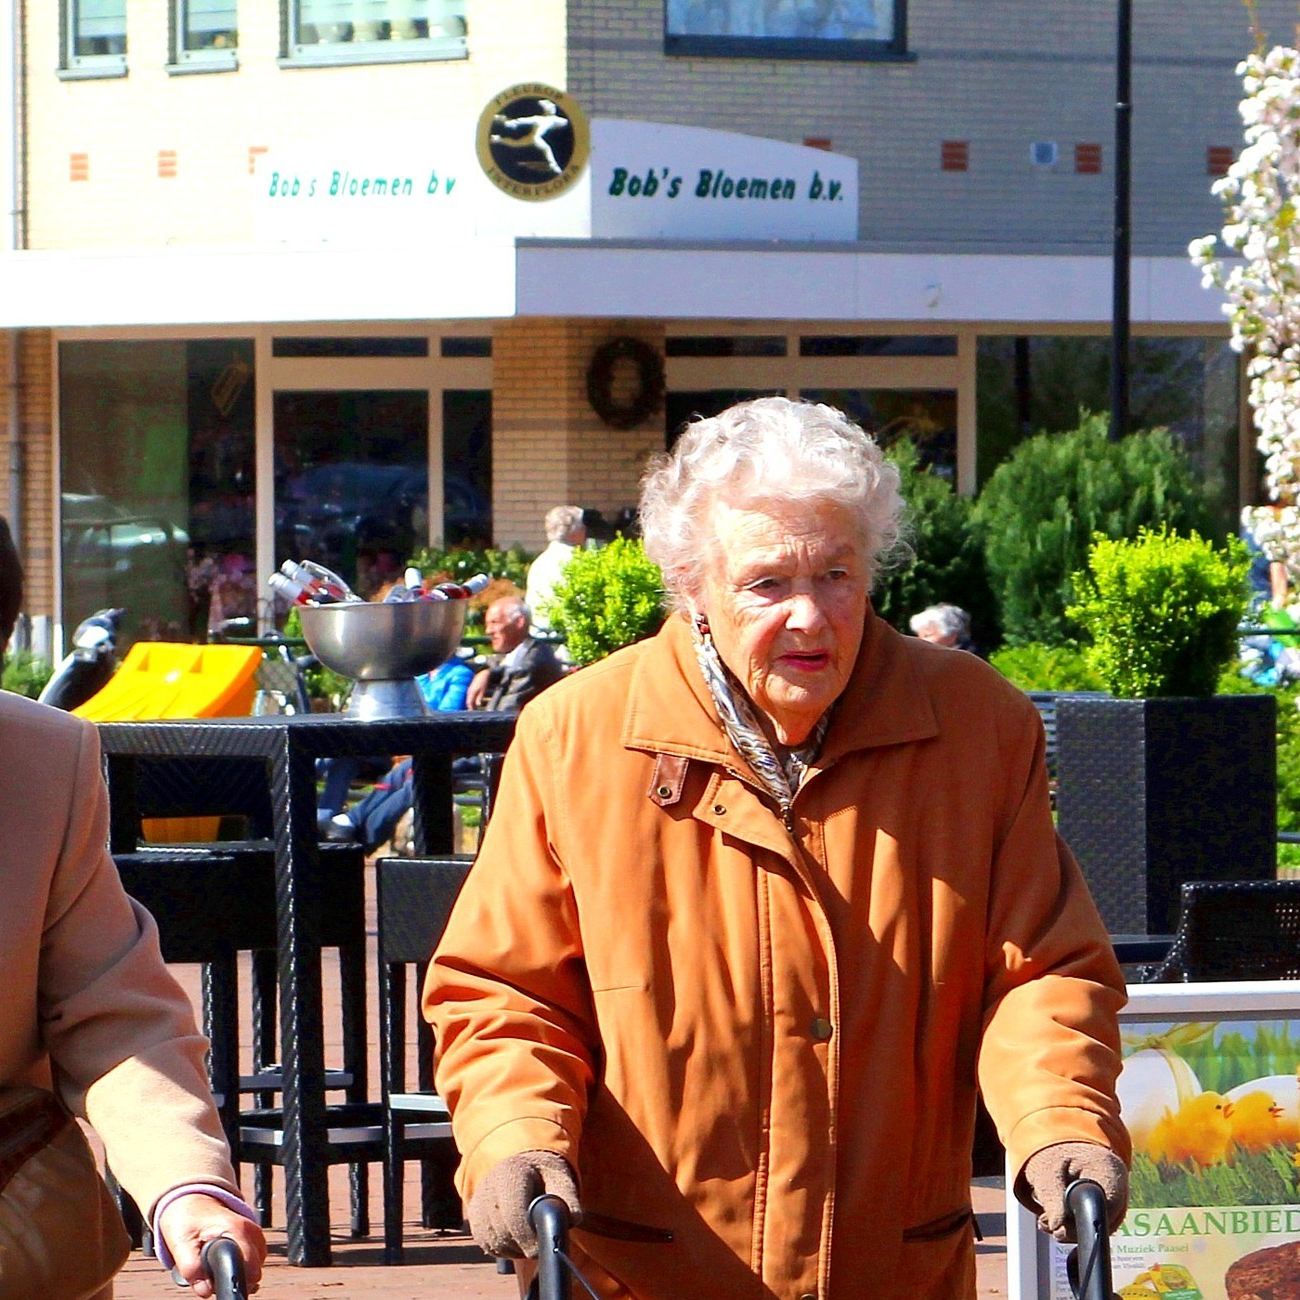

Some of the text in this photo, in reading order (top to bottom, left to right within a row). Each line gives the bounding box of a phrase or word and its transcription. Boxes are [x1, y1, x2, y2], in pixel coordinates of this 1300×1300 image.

[269, 171, 317, 197] Bobs
[329, 170, 413, 196] Bloemen
[609, 167, 843, 200] Bob's Bloemen b.v.
[1117, 1243, 1189, 1254] Muziek Paasei
